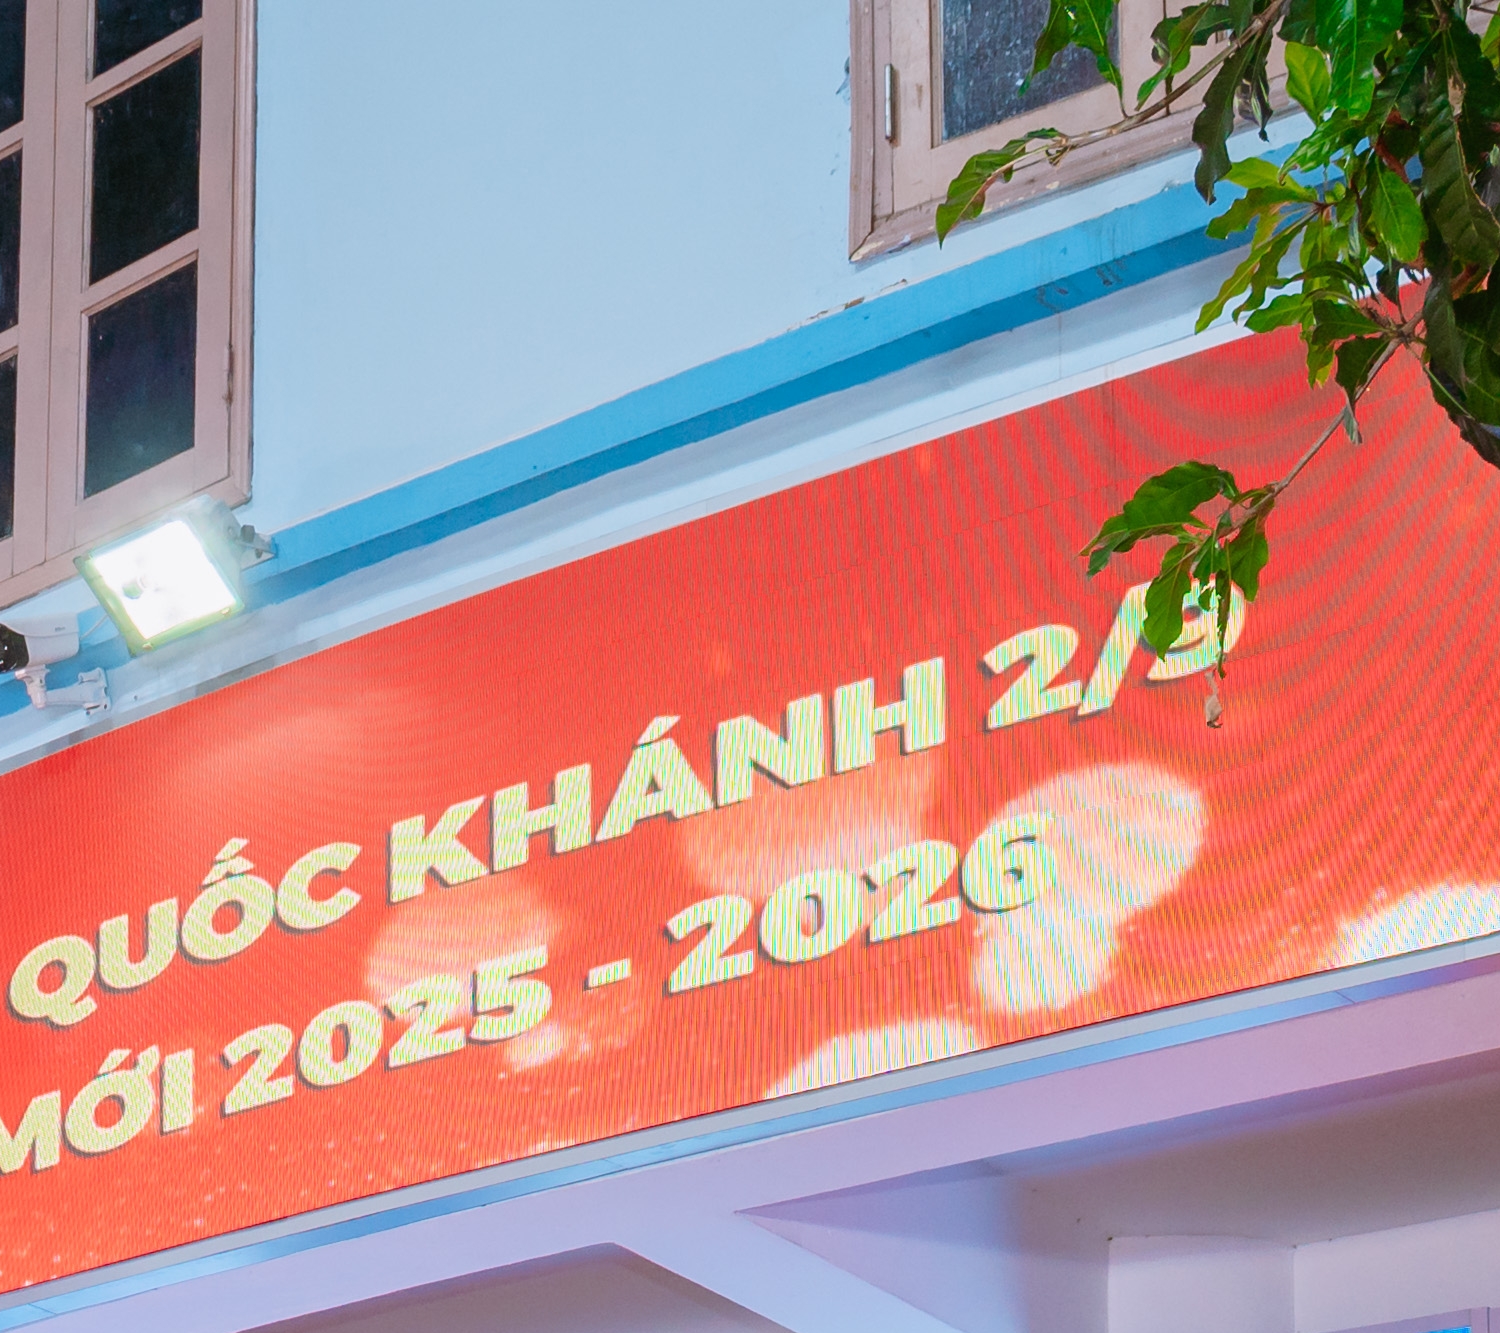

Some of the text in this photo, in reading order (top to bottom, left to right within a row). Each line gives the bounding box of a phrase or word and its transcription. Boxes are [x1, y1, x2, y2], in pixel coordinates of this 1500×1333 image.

[8, 837, 362, 1027] QUỐC
[386, 655, 946, 904] KHÁNH
[982, 577, 1246, 730] 2/9
[221, 946, 553, 1117] 2025
[666, 810, 1056, 995] 2026
